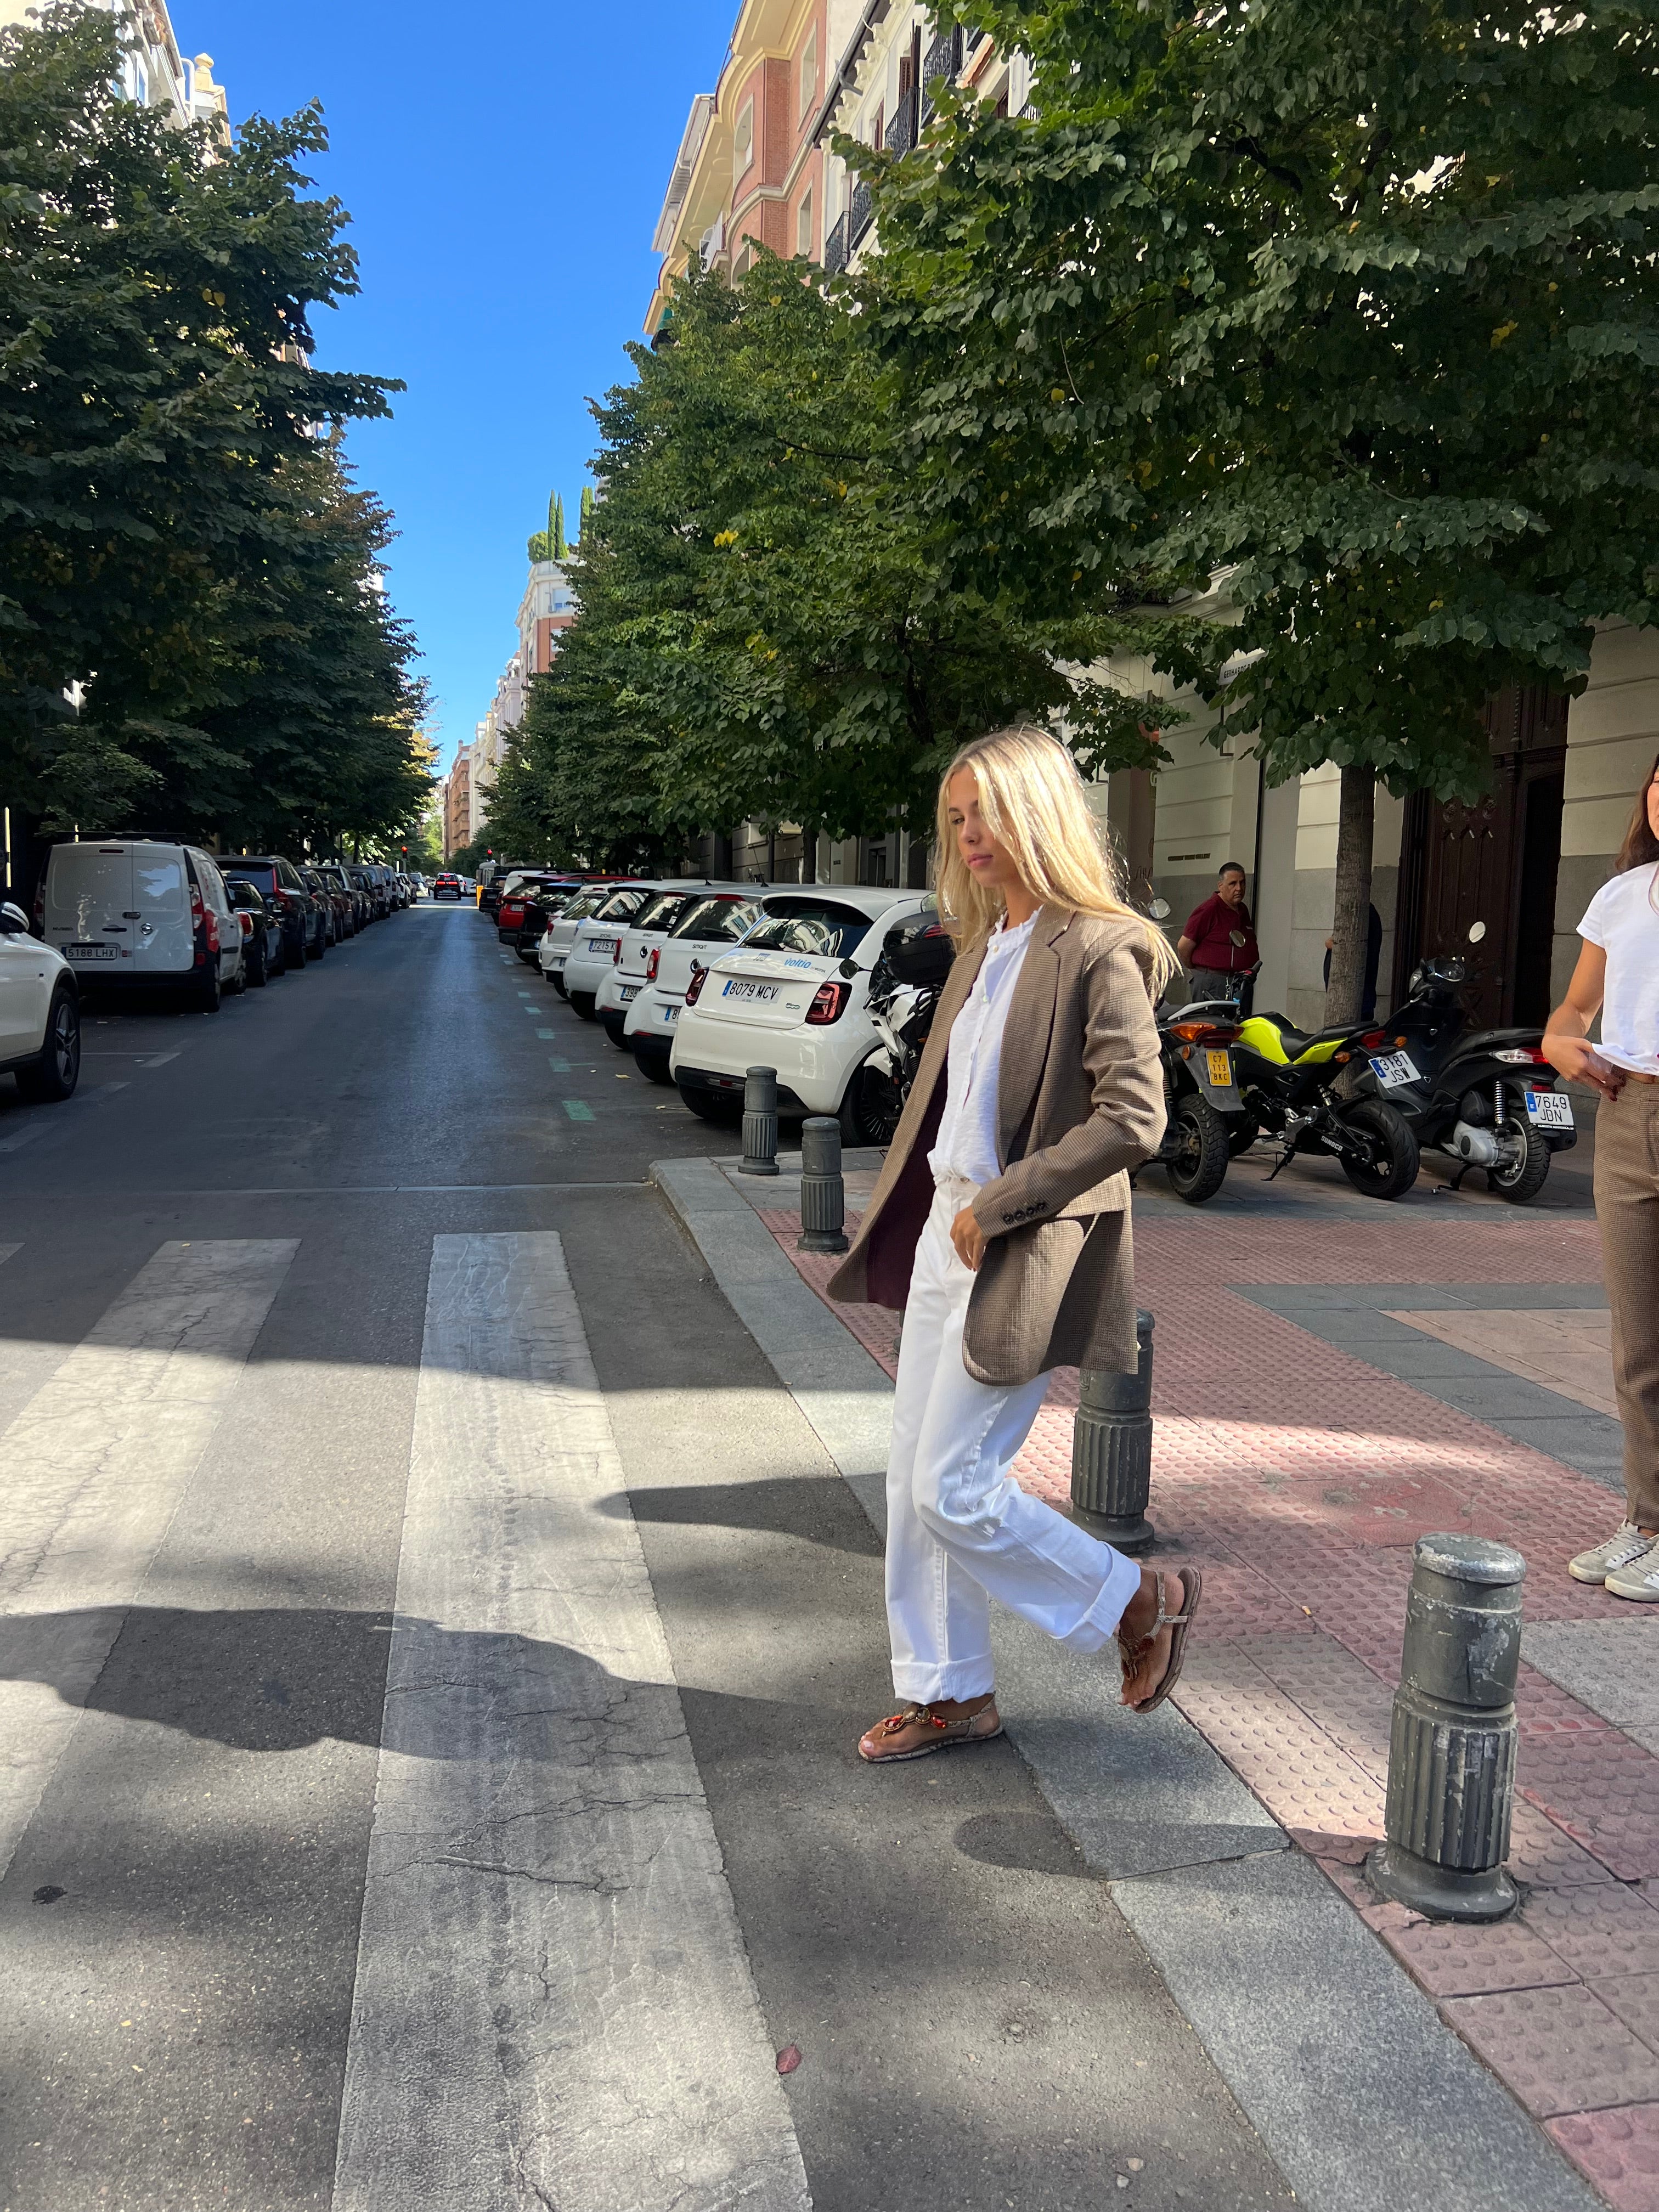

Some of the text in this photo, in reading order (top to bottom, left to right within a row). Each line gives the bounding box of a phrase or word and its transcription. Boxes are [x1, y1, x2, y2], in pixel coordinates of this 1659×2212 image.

[594, 941, 610, 950] 7215
[68, 949, 93, 957] 5188
[95, 949, 115, 957] LHX
[783, 957, 811, 968] voltio
[625, 988, 641, 998] 398
[729, 983, 779, 1000] 8079 MCV
[1379, 1053, 1408, 1070] 3181
[1390, 1067, 1410, 1083] JSW
[1535, 1096, 1567, 1109] 7649
[1540, 1109, 1562, 1122] JDN
[1321, 1135, 1344, 1152] SUNOCO
